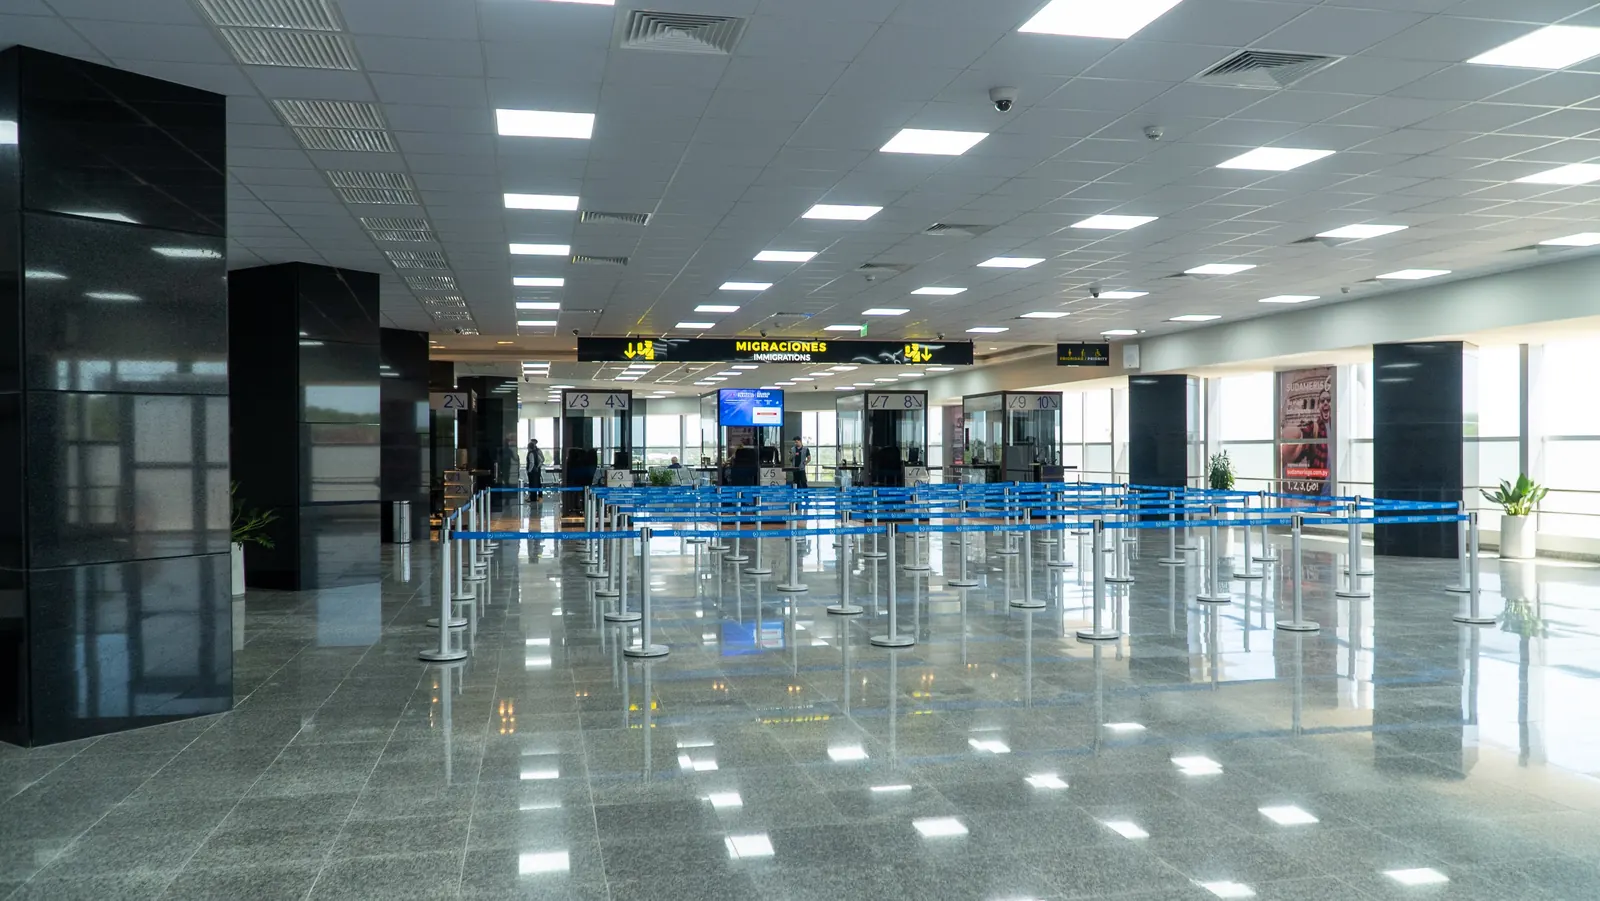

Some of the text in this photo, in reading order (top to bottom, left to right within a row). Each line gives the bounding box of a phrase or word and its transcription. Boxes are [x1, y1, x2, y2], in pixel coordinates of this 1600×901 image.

[736, 341, 827, 352] MIGRACIONES
[753, 353, 811, 361] IMMIGRATIONS
[444, 394, 453, 408] 2
[580, 394, 615, 408] 3 4
[880, 395, 913, 408] 7 8
[1018, 395, 1049, 409] 9 10
[617, 471, 624, 480] 3
[770, 469, 776, 478] 5
[915, 468, 920, 476] 7
